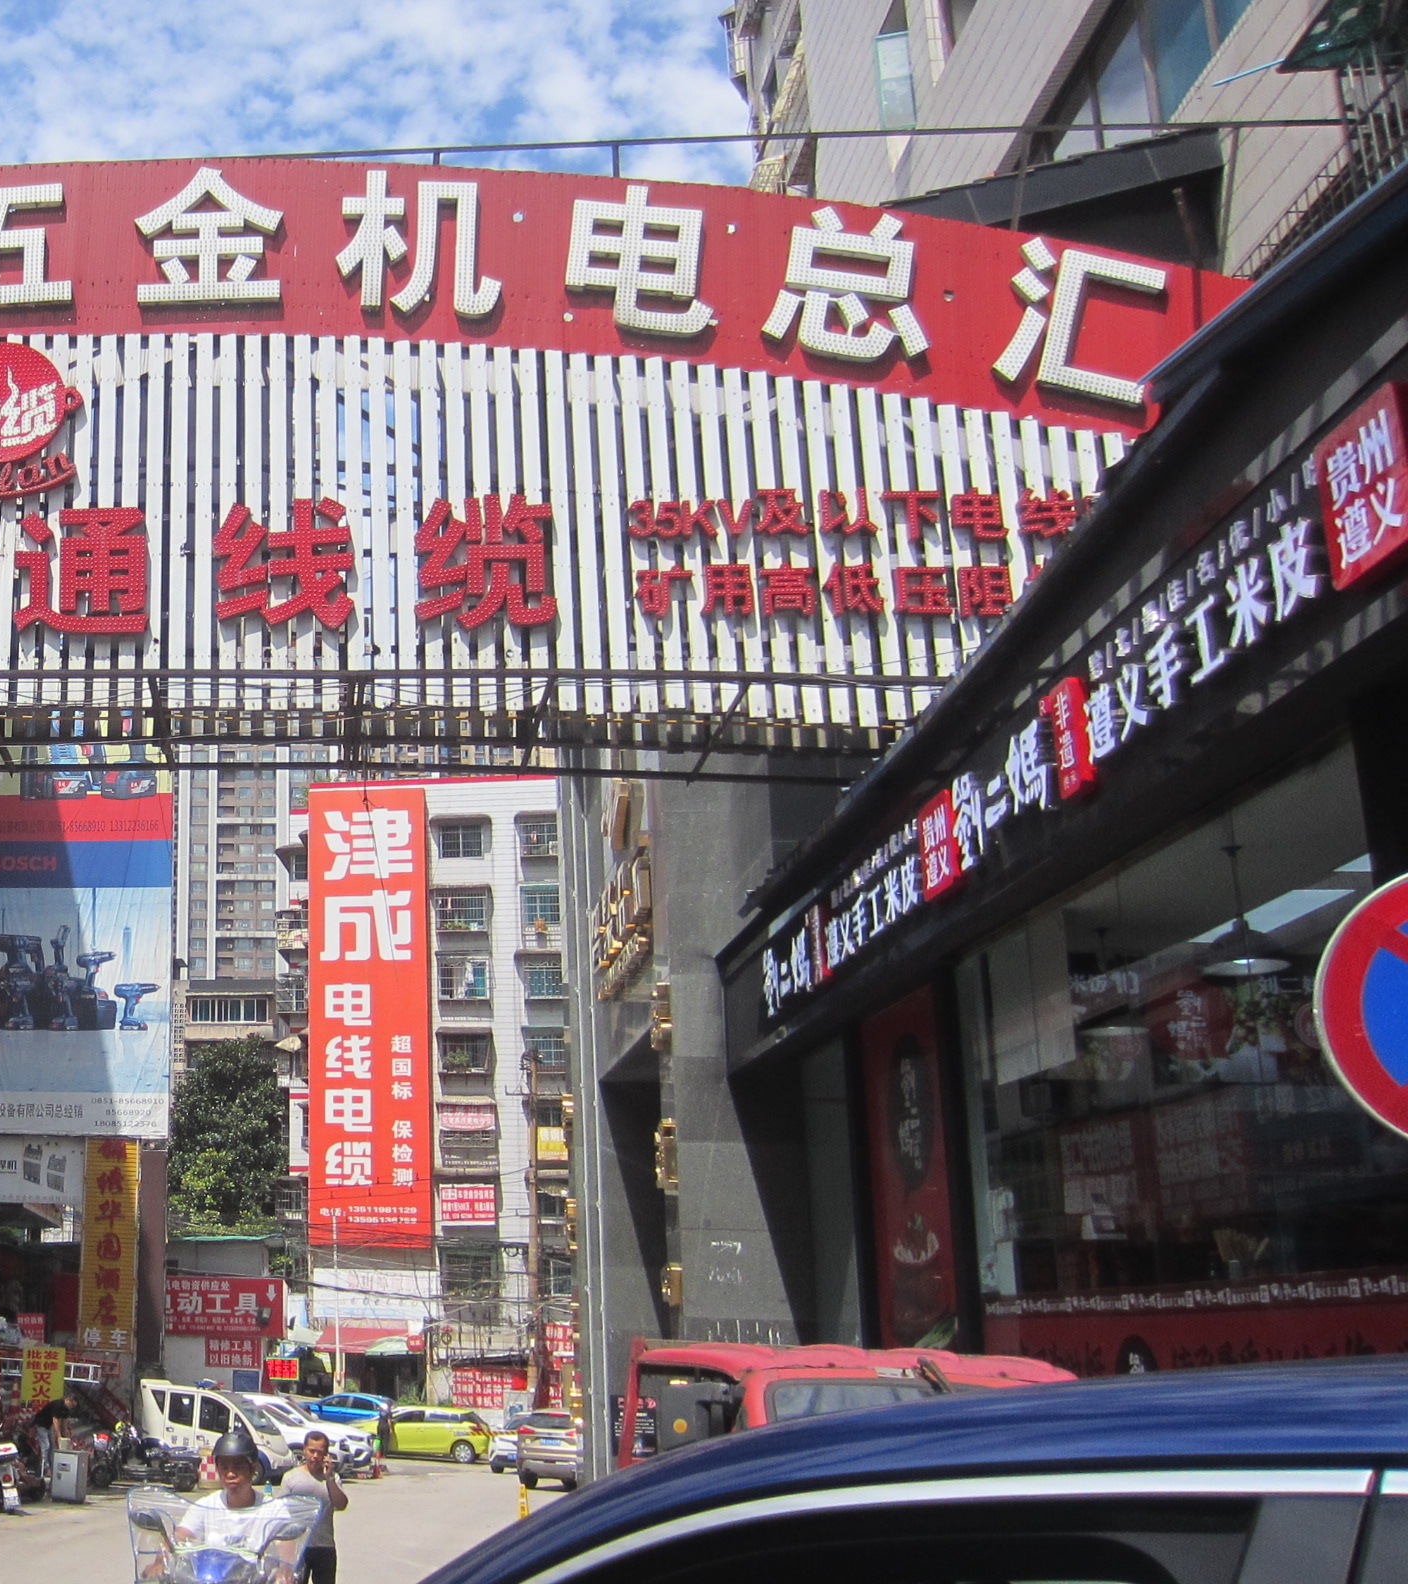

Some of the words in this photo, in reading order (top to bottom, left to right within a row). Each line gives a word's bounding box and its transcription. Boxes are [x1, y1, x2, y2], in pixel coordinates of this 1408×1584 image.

[1326, 408, 1396, 502] 贵州
[628, 486, 1092, 544] 35KV及以下电线
[1334, 477, 1404, 571] 遵义
[635, 562, 1048, 618] 矿用高低压阻
[1082, 518, 1320, 766] 遵义手工米皮
[923, 803, 948, 854] 贵州
[320, 809, 413, 962] 津成
[926, 846, 951, 891] 遵义
[825, 855, 920, 969] 遵义手工米皮
[324, 982, 374, 1187] 电线电缆
[390, 1034, 413, 1101] 超国标
[391, 1119, 414, 1188] 保检测
[347, 1204, 418, 1216] 13511981129
[26, 1361, 59, 1371] 维修
[27, 1349, 59, 1360] 批发
[83, 1327, 128, 1348] 停车
[209, 1354, 253, 1367] 以旧换新
